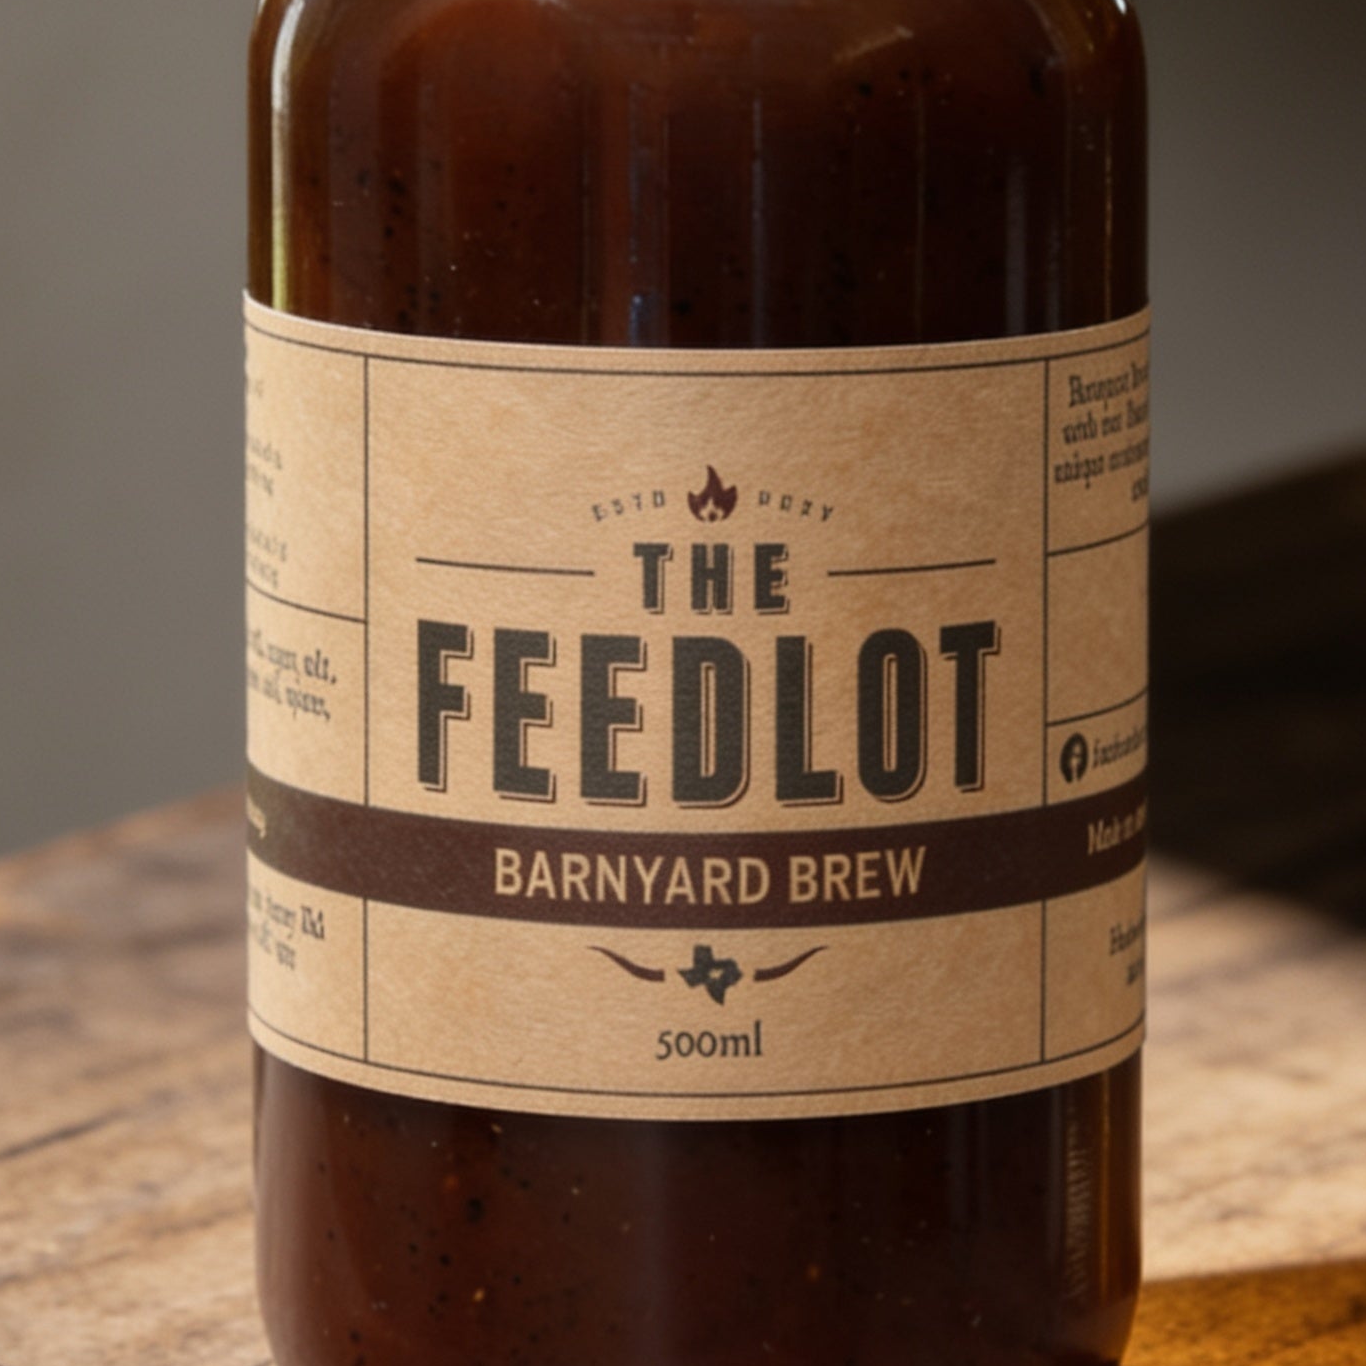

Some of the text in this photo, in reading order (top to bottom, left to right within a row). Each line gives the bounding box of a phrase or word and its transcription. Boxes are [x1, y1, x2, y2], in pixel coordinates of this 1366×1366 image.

[633, 542, 790, 615] THE
[417, 618, 1001, 809] FEEDLOT
[493, 845, 927, 905] BARNYARD BREW
[655, 1020, 763, 1061] 500ml
